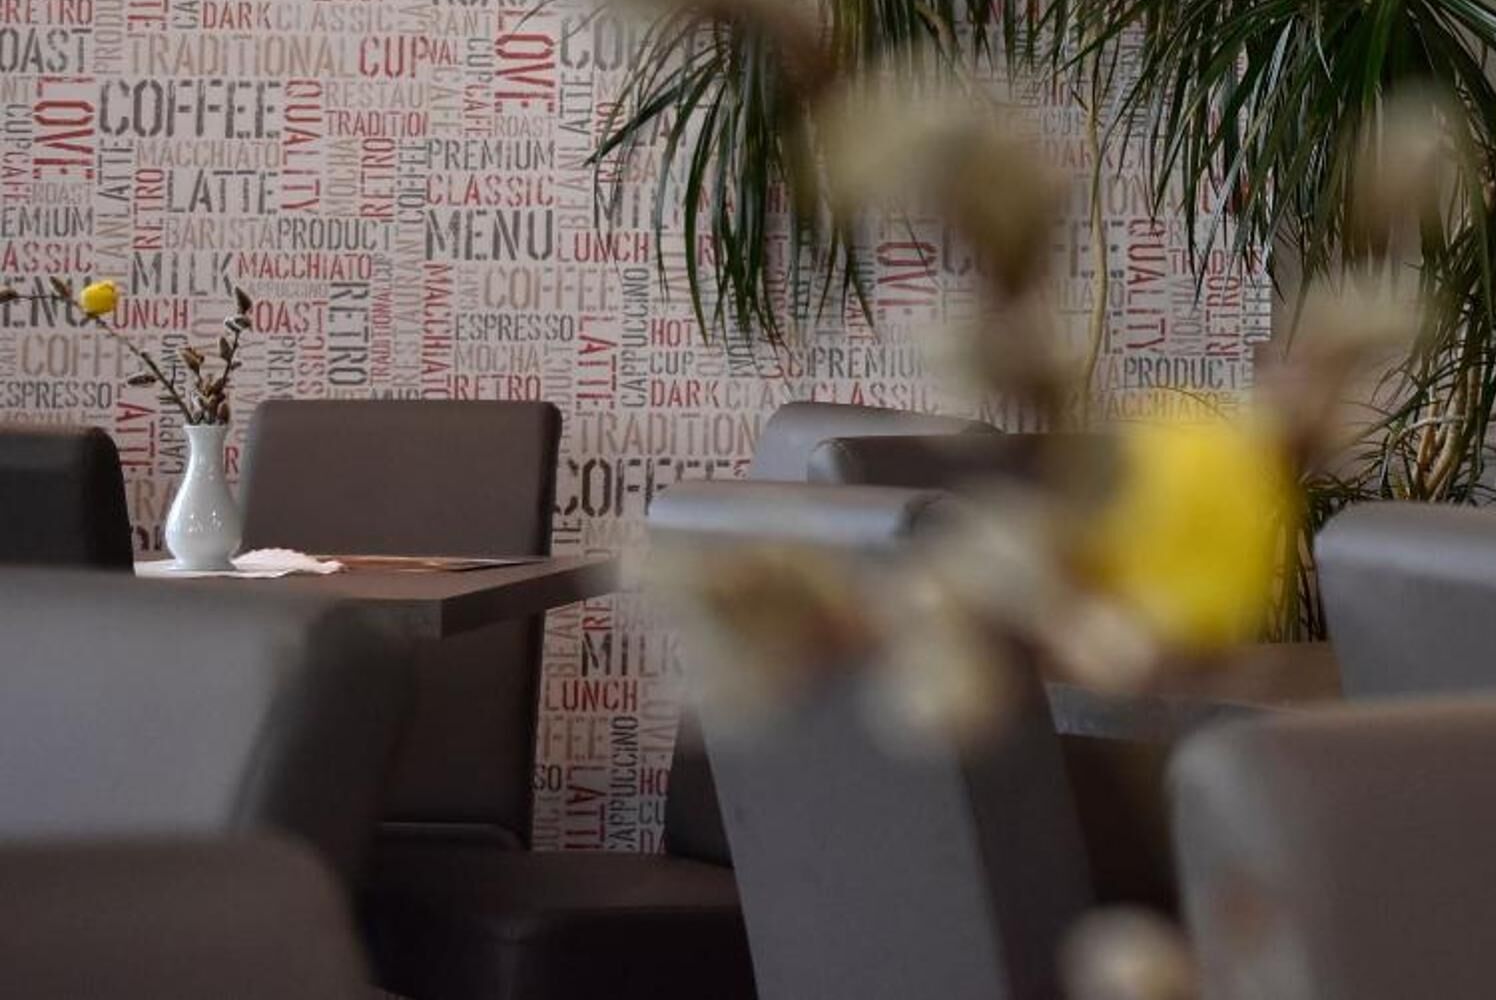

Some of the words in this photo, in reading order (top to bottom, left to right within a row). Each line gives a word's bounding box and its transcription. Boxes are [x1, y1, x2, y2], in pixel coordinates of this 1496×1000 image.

[202, 0, 272, 31] DARK
[127, 33, 358, 78] TRADITIONAL
[359, 33, 431, 78] CUP
[494, 9, 556, 113] LOVE
[33, 75, 95, 180] LOVE
[99, 78, 282, 139] COFFEE
[280, 79, 323, 216] QUALITY
[428, 138, 554, 172] PREMIUM
[167, 170, 279, 214] LATTE
[424, 173, 554, 208] CLASSIC
[276, 216, 394, 251] PRODUCT
[424, 209, 553, 262] MENU
[557, 231, 651, 264] LUNCH
[131, 251, 235, 296] MILK
[238, 251, 373, 281] MACCHIATO
[484, 264, 620, 311] COFFEE
[1125, 218, 1167, 355] QUALITY
[326, 282, 370, 387] RETRO
[454, 314, 576, 342] ESPRESSO
[620, 266, 650, 409] CAPPUCCINO
[650, 317, 697, 348] HOT
[575, 315, 618, 411] LATTE
[1122, 355, 1240, 390] PRODUCT
[454, 374, 541, 401] RETRO
[650, 378, 720, 410] DARK
[580, 632, 685, 678] MILK
[546, 679, 640, 713] LUNCH
